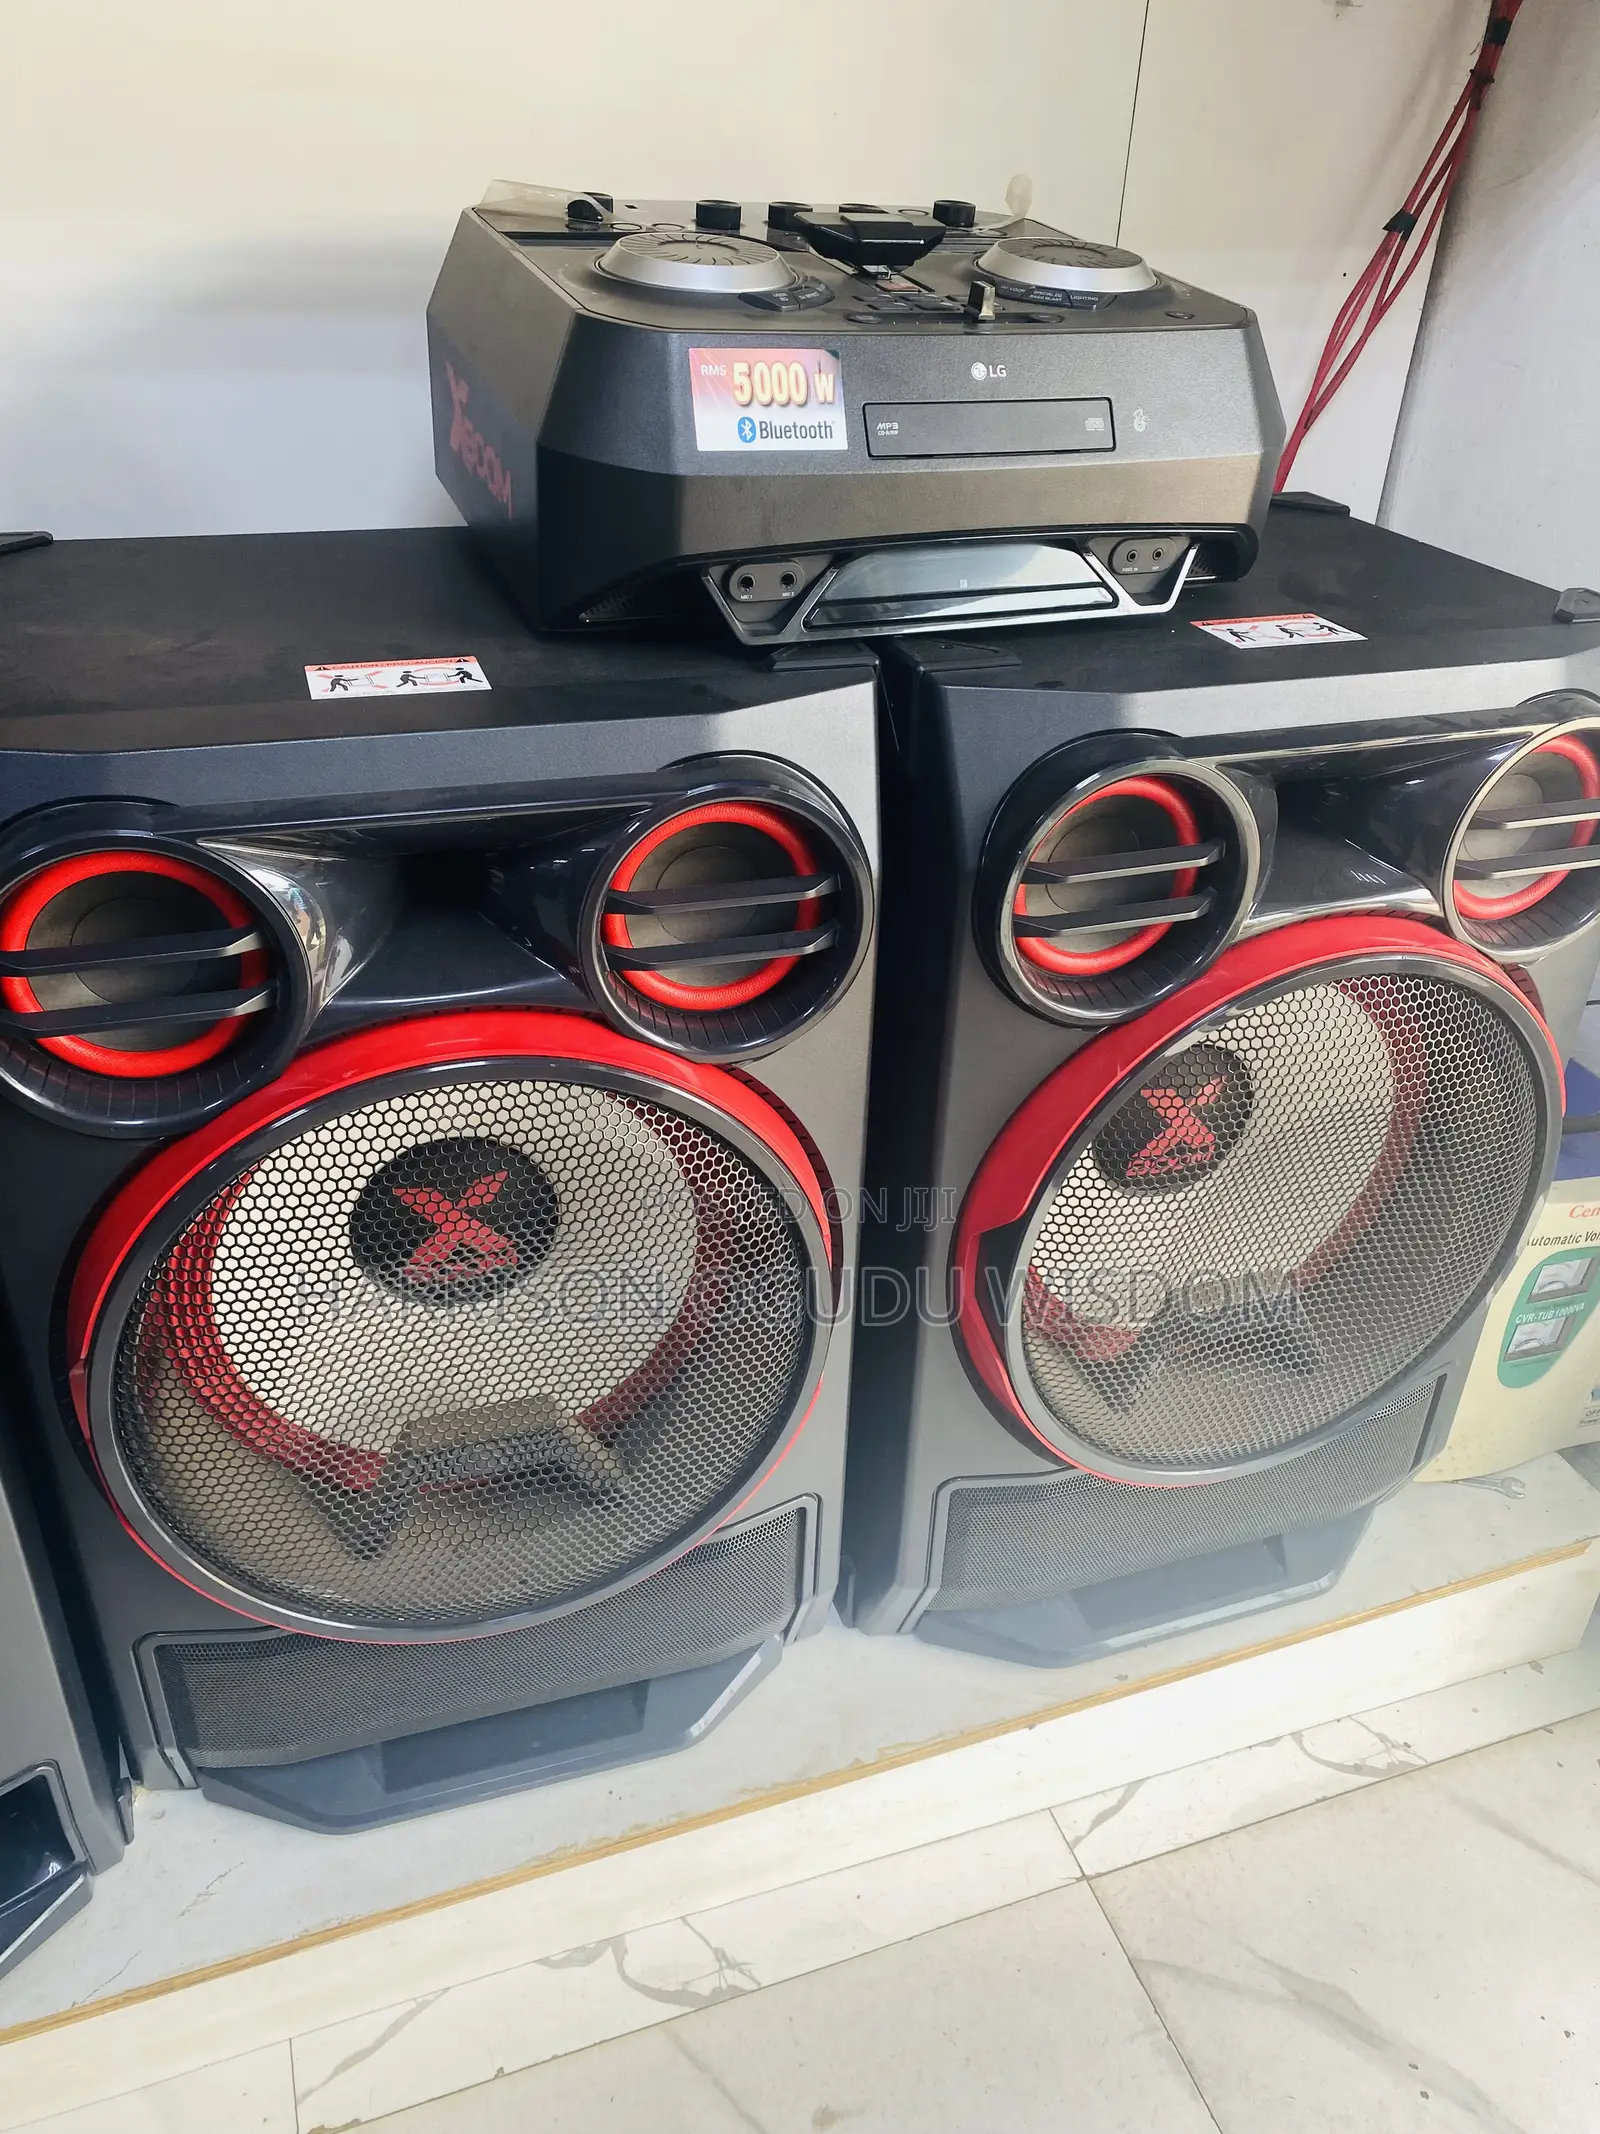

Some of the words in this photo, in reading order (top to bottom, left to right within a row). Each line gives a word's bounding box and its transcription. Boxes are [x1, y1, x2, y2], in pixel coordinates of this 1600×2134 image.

[989, 364, 1007, 378] LG
[700, 365, 727, 376] RMS
[733, 361, 809, 406] 5000
[759, 420, 834, 440] Bluetooth
[876, 422, 899, 430] MP3
[1526, 1232, 1582, 1247] utomatic
[1515, 1310, 1555, 1324] CVR-TUB
